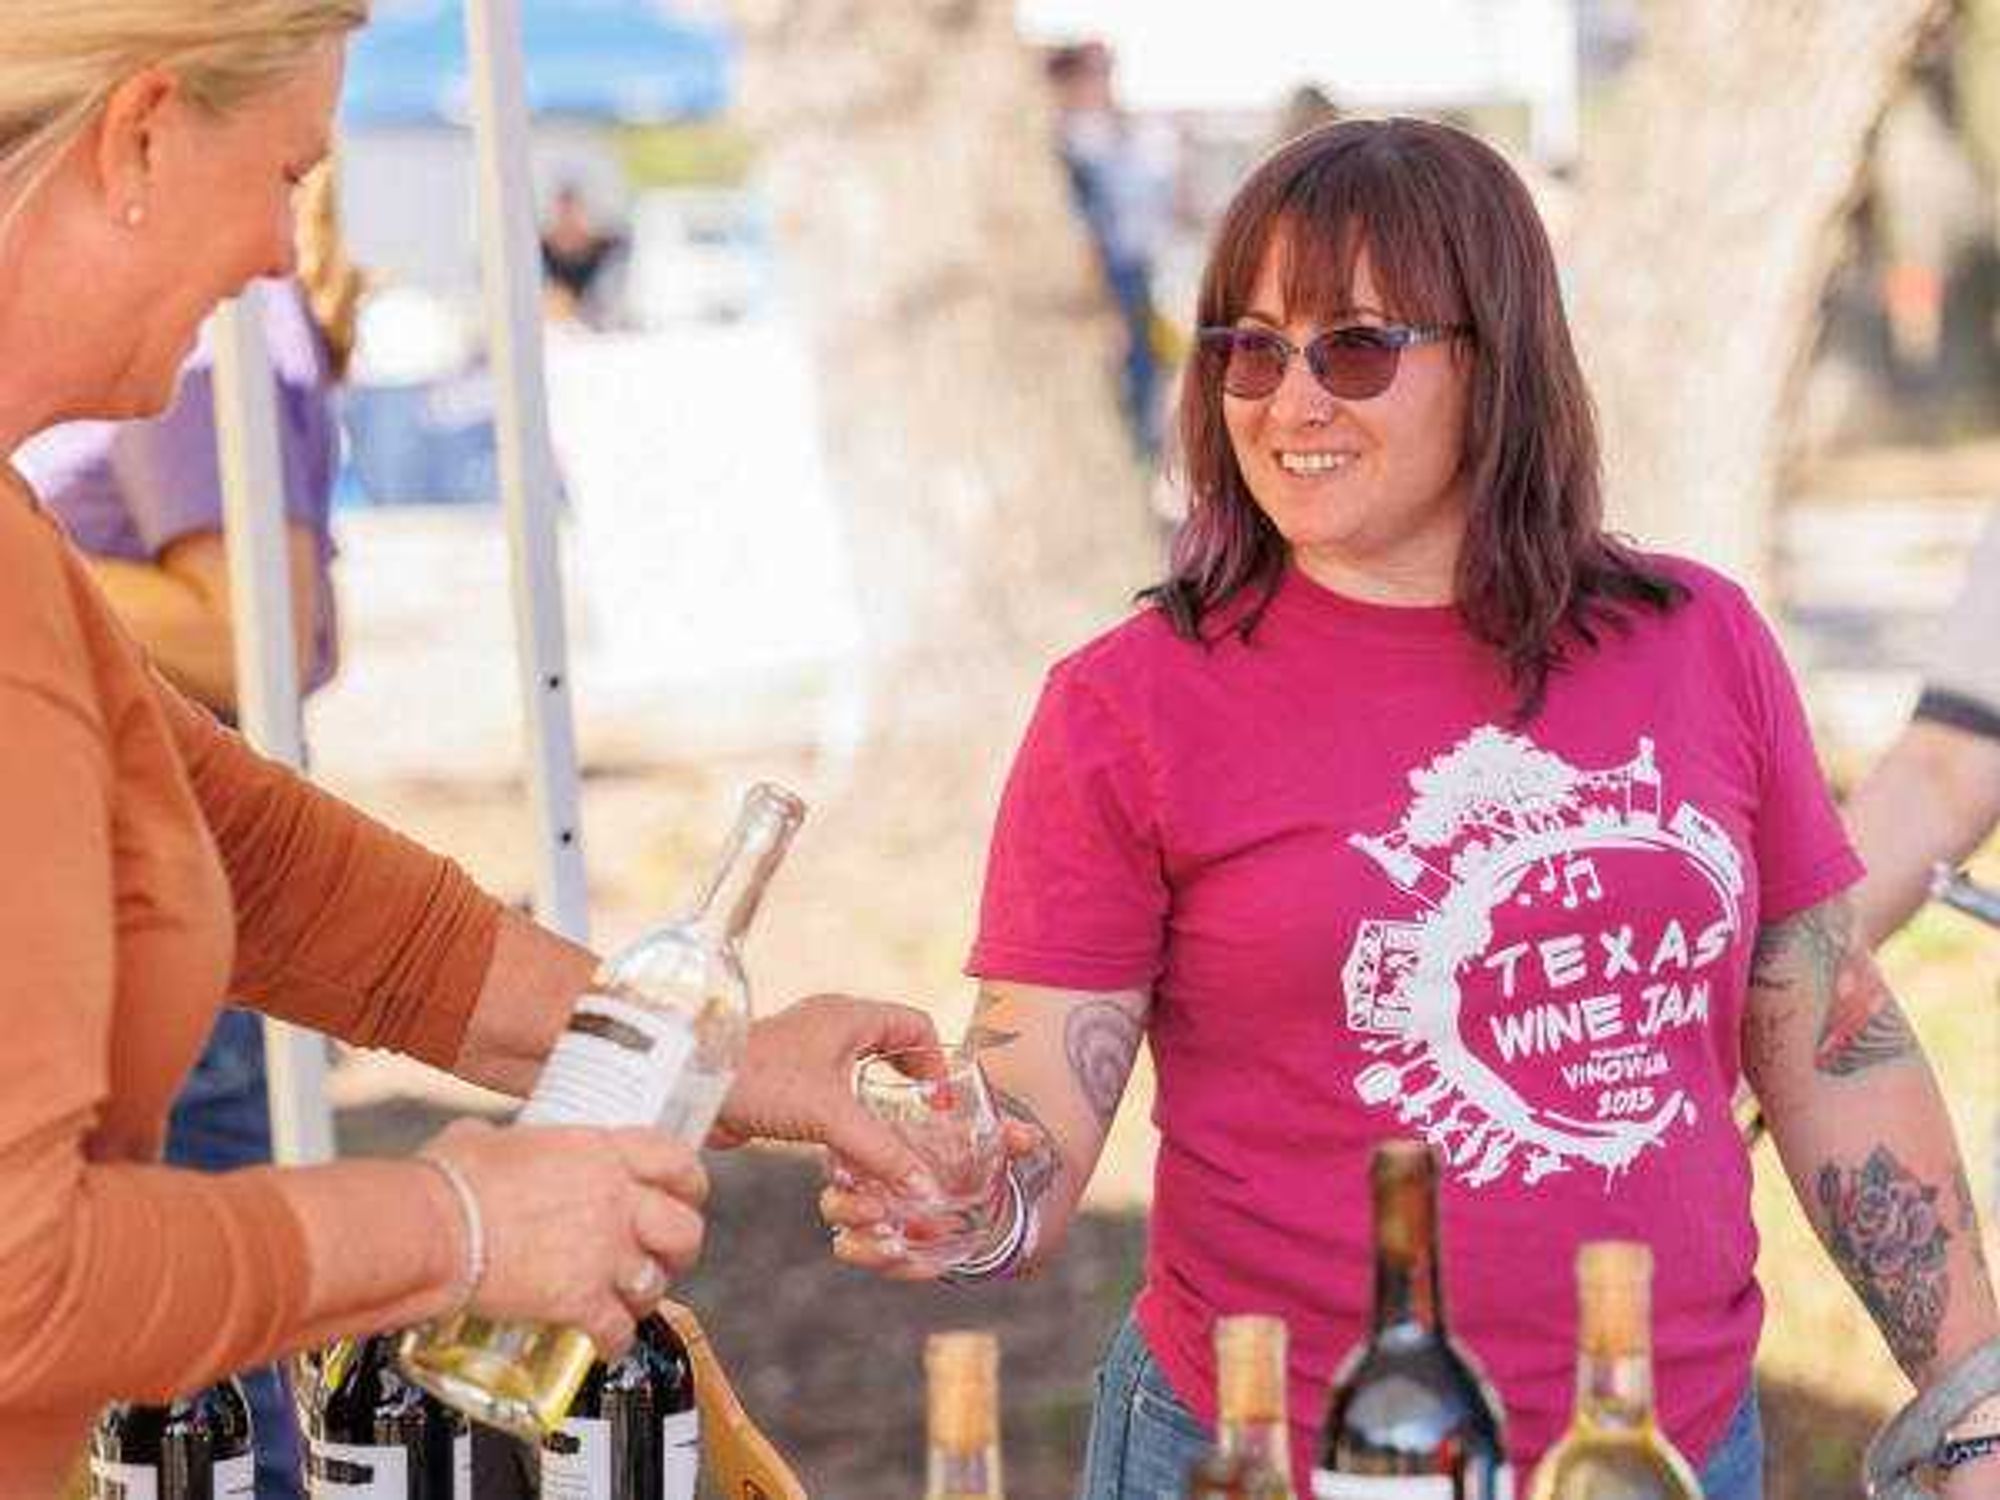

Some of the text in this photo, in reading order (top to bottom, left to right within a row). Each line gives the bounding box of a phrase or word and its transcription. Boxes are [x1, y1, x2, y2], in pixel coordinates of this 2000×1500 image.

[1484, 918, 1733, 998] TEXAS
[1489, 979, 1709, 1063] WINE JAM
